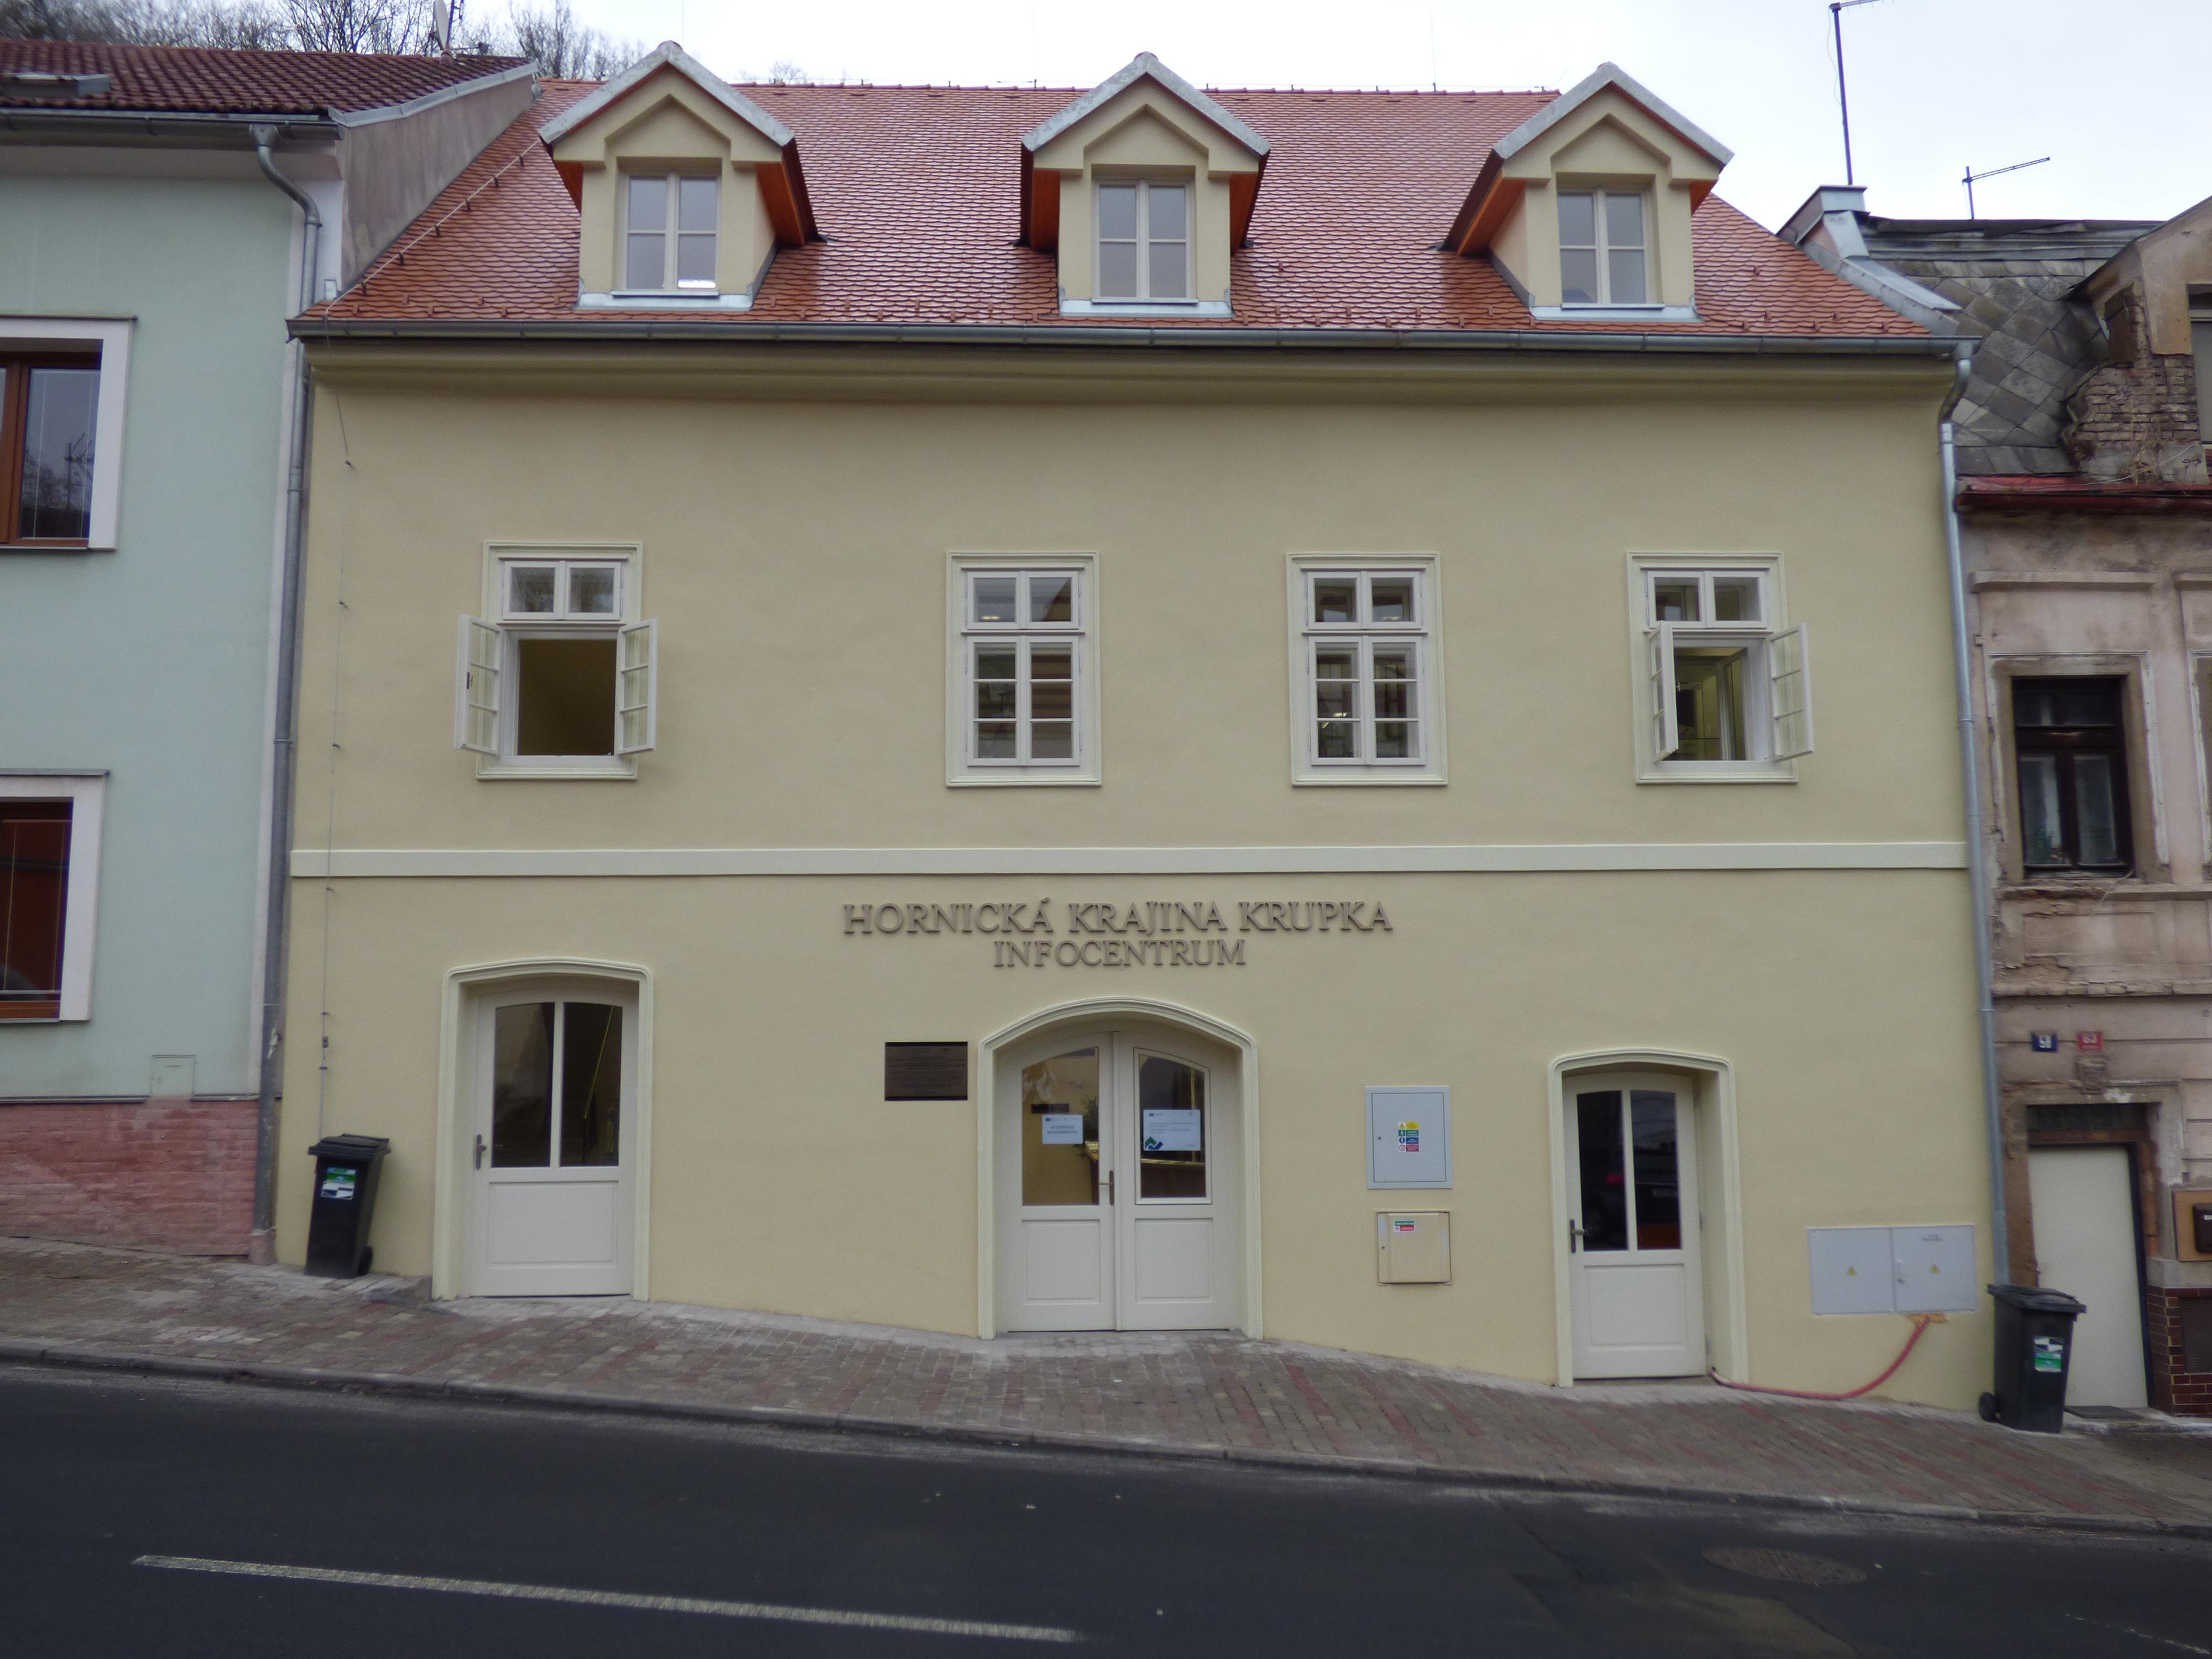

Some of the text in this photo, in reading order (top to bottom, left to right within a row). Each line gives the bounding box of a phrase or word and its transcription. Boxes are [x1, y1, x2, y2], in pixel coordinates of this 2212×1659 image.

[843, 896, 1393, 936] HORNICKÁ KRAJINA KRUPKA
[994, 938, 1246, 967] INFOCENTRUM
